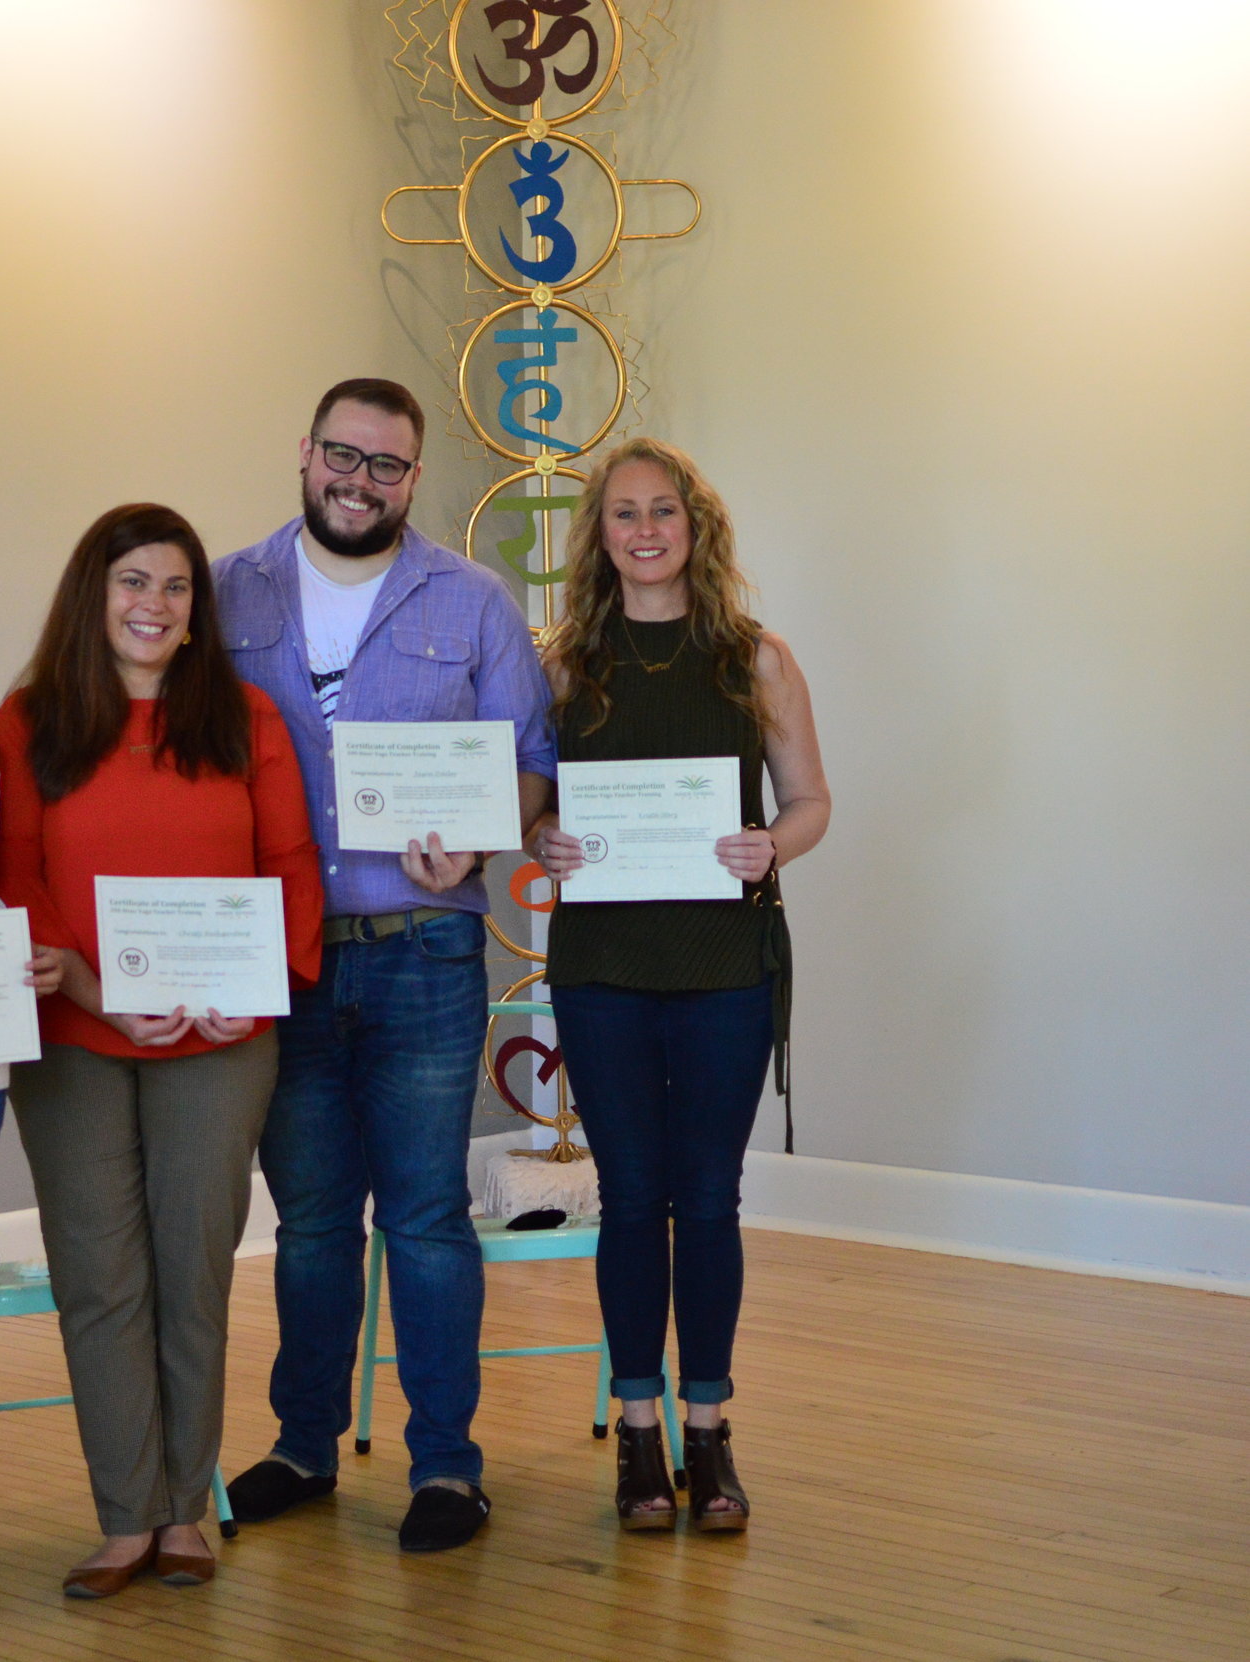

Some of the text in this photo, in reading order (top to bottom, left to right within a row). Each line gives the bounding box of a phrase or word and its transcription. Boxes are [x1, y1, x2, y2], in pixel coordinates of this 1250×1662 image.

[397, 743, 440, 751] Completion
[571, 782, 666, 792] Certificate of Completion
